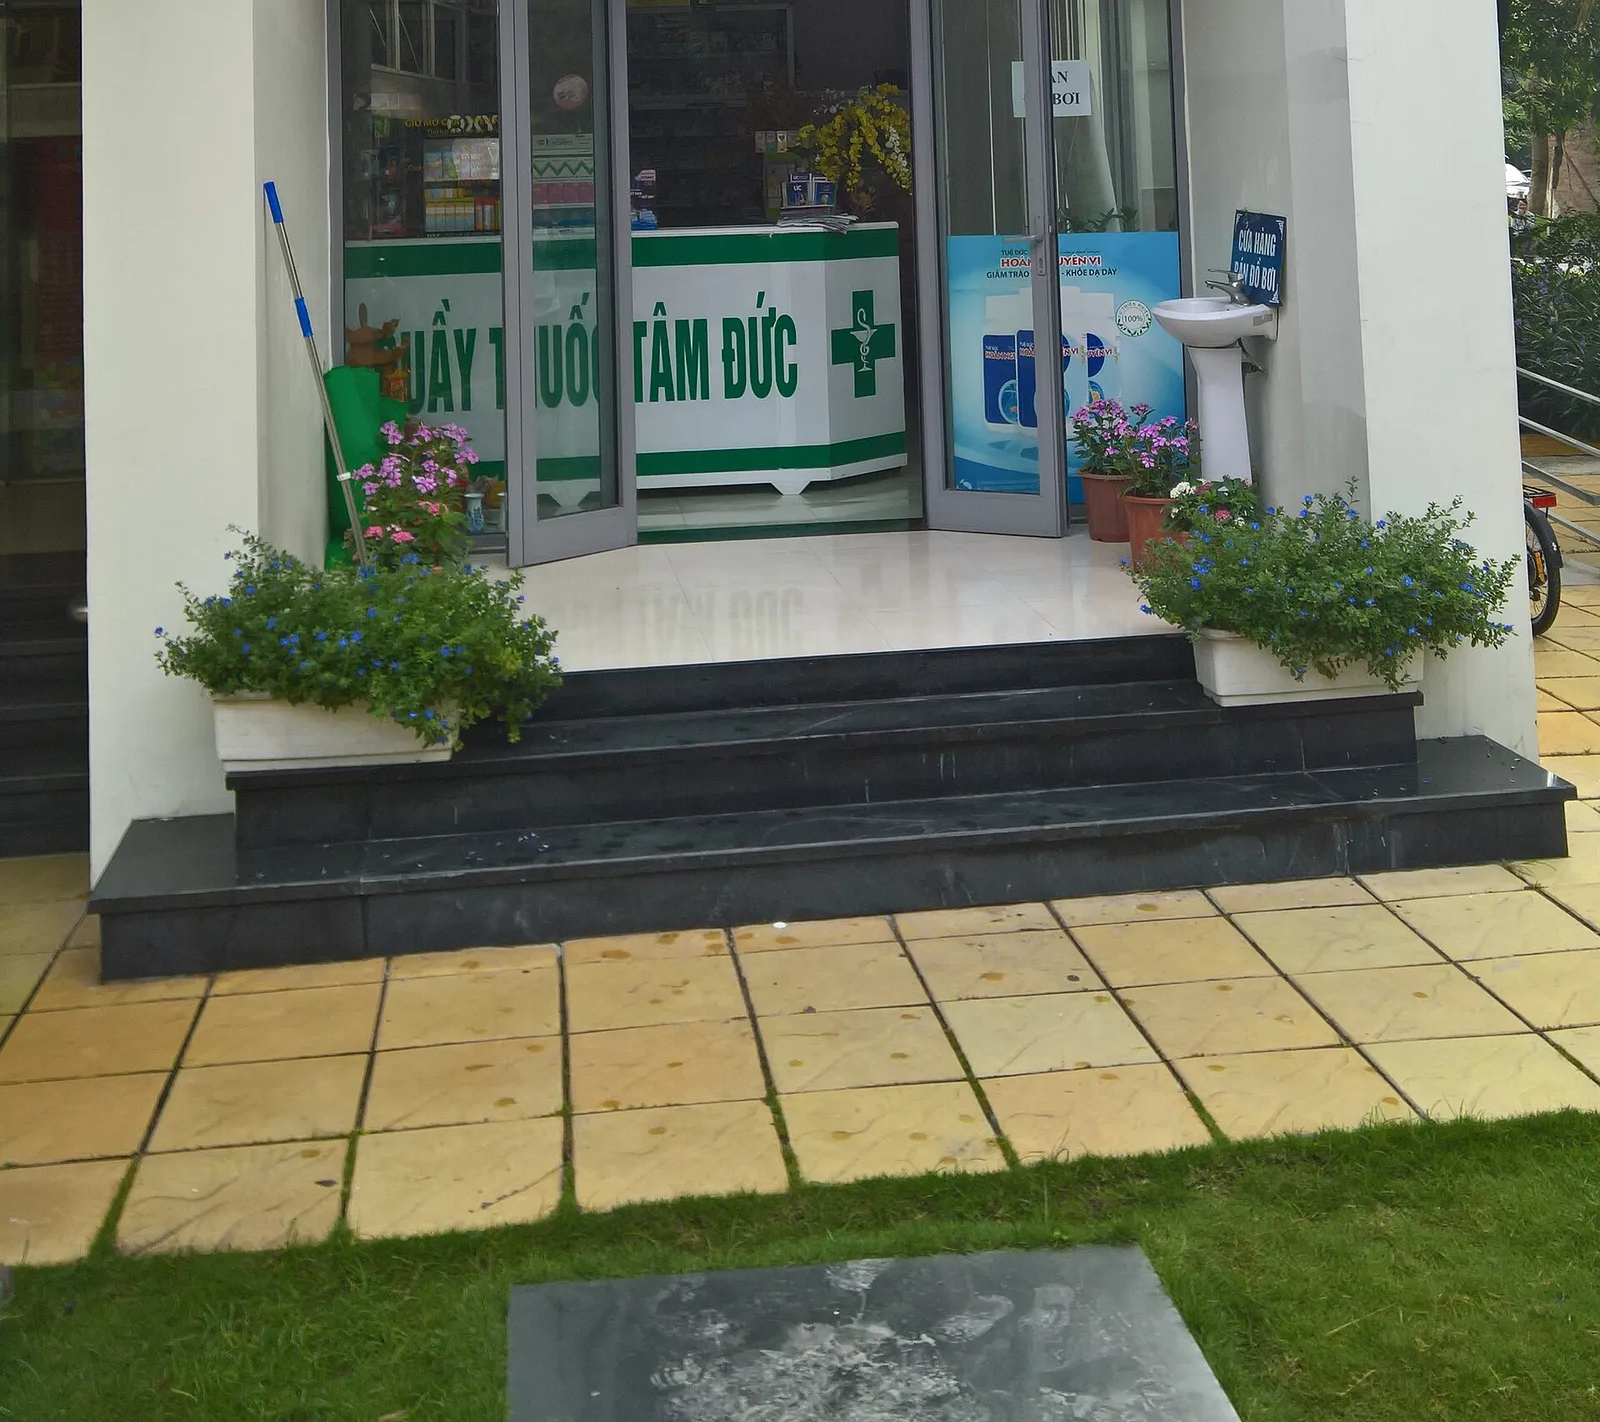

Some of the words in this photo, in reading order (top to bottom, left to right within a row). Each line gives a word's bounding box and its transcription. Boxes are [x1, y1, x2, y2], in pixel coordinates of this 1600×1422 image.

[1238, 221, 1253, 253] CỬA
[1253, 226, 1277, 257] HÀNG
[1248, 256, 1262, 288] ĐỒ
[1261, 266, 1277, 292] BƠI
[633, 301, 710, 404] TÂM
[721, 291, 798, 399] ĐỨC
